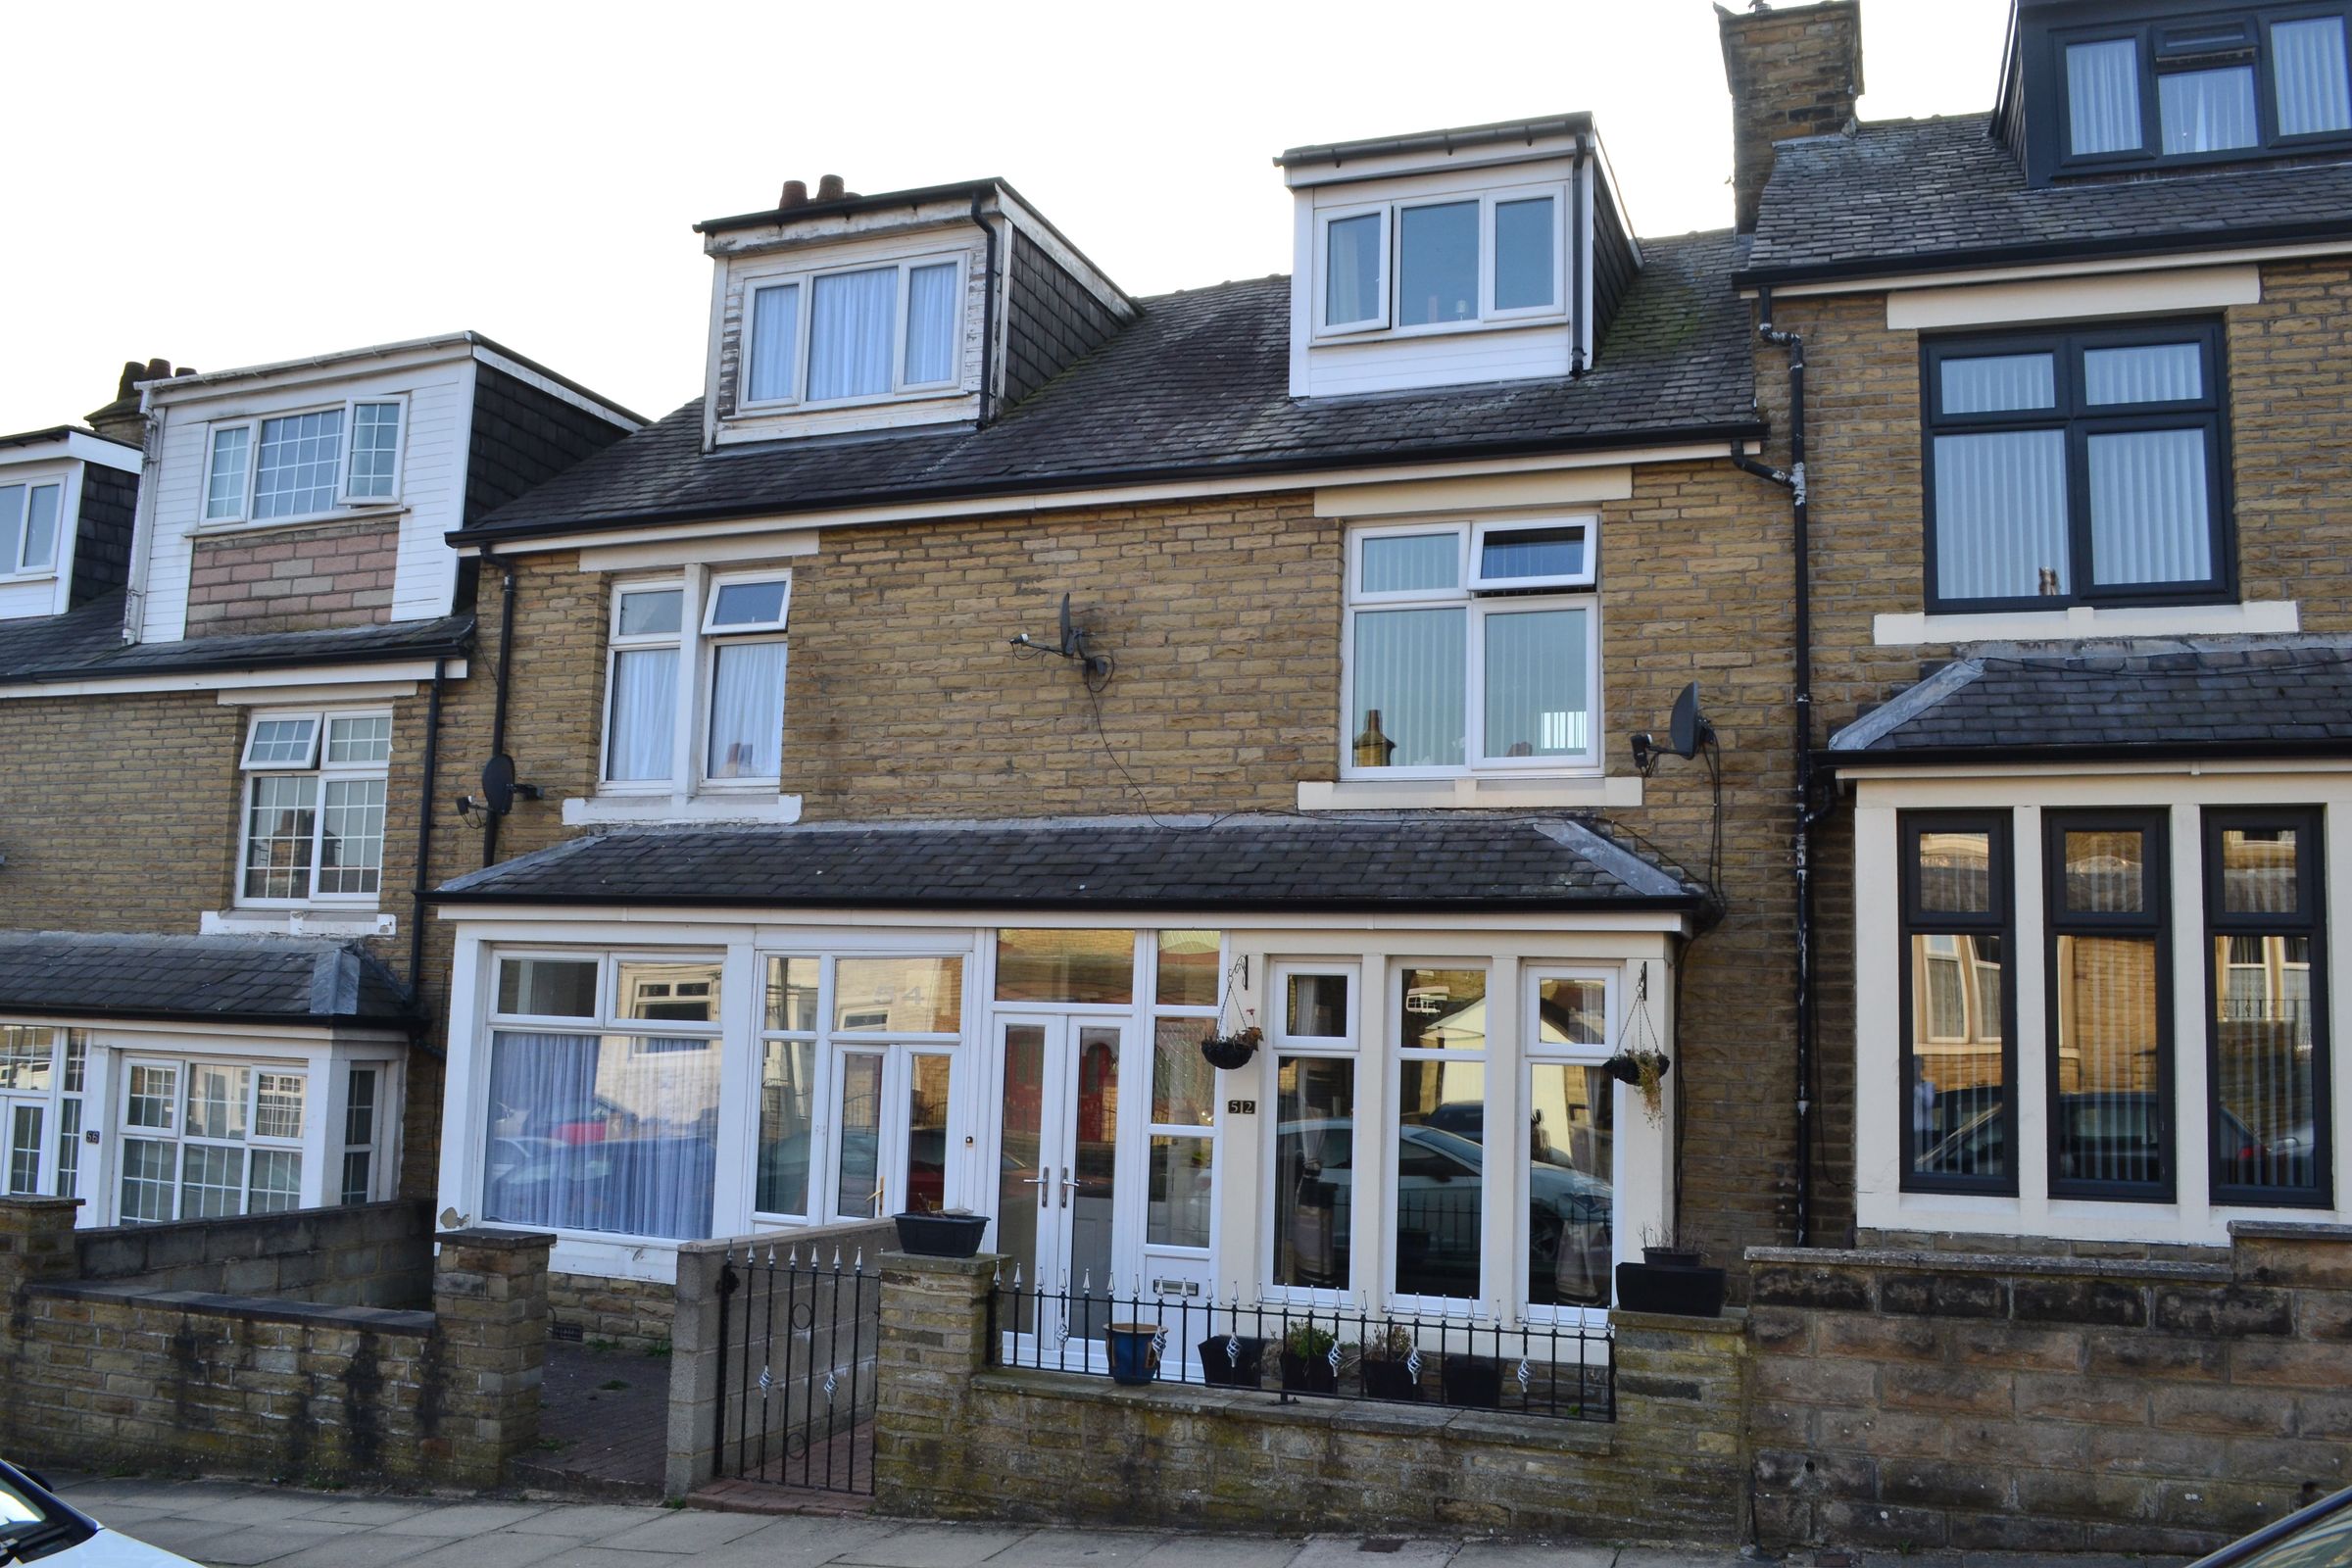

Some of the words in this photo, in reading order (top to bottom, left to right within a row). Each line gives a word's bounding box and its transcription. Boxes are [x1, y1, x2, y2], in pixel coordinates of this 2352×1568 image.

[874, 985, 924, 1004] 54
[1230, 1101, 1253, 1113] 52
[87, 1131, 99, 1143] 56
